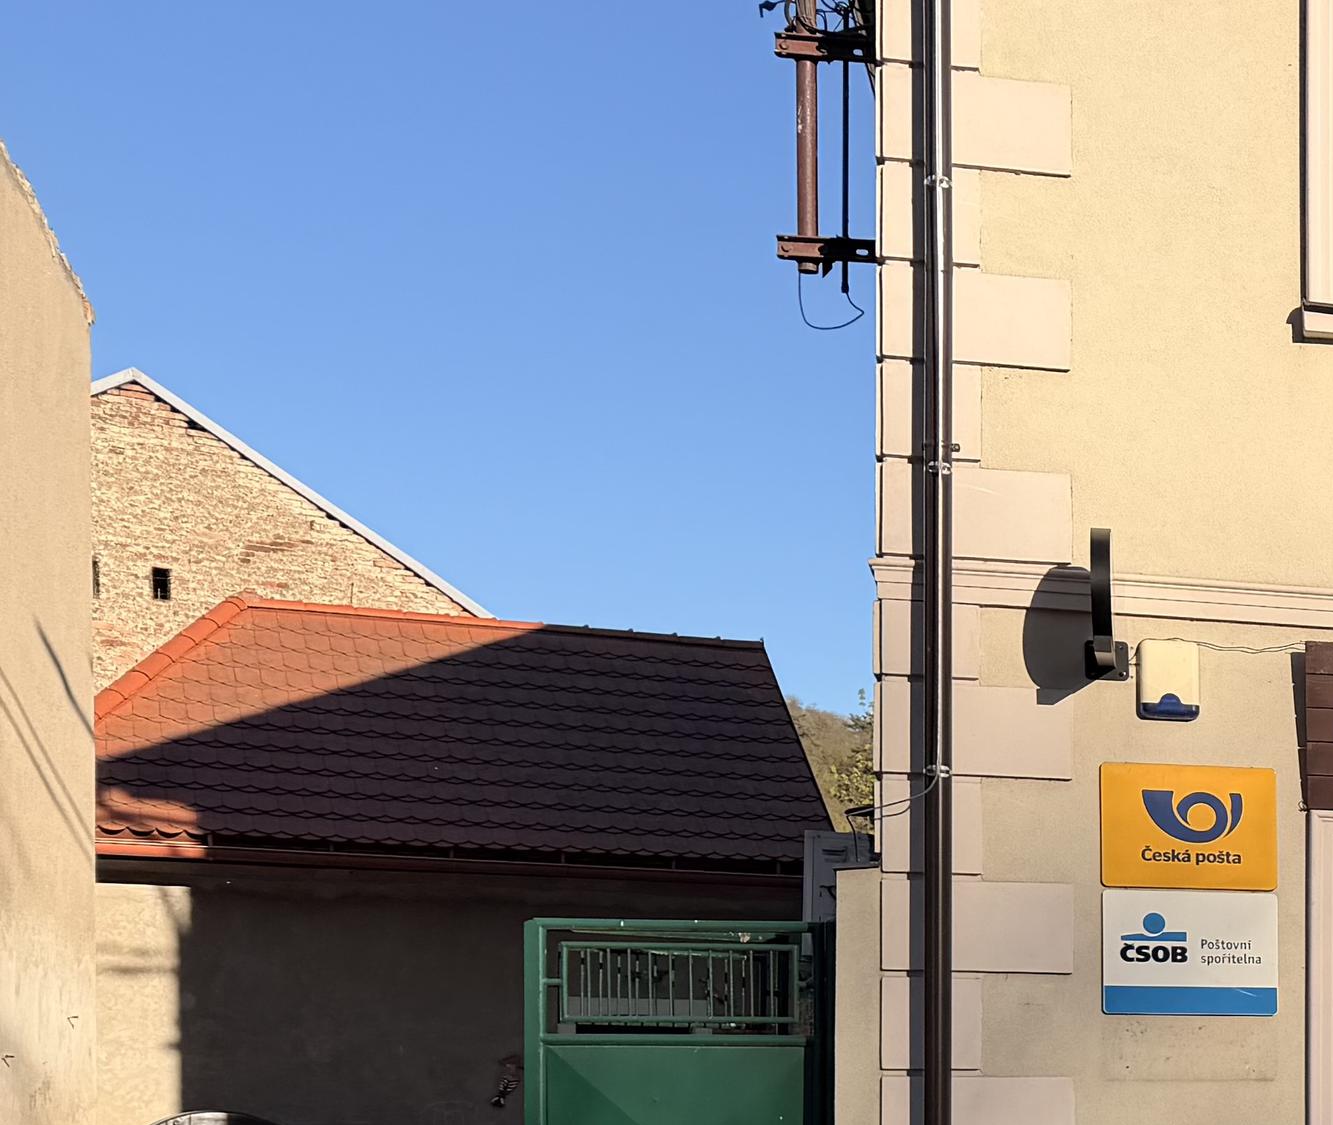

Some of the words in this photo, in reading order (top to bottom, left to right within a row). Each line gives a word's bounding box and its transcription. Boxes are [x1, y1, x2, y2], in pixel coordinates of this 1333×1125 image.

[1141, 845, 1191, 863] Česká
[1195, 848, 1242, 866] pošta
[1120, 942, 1188, 964] ČSOB
[1200, 938, 1252, 951] Poštovní
[1200, 953, 1262, 966] spořitelna
